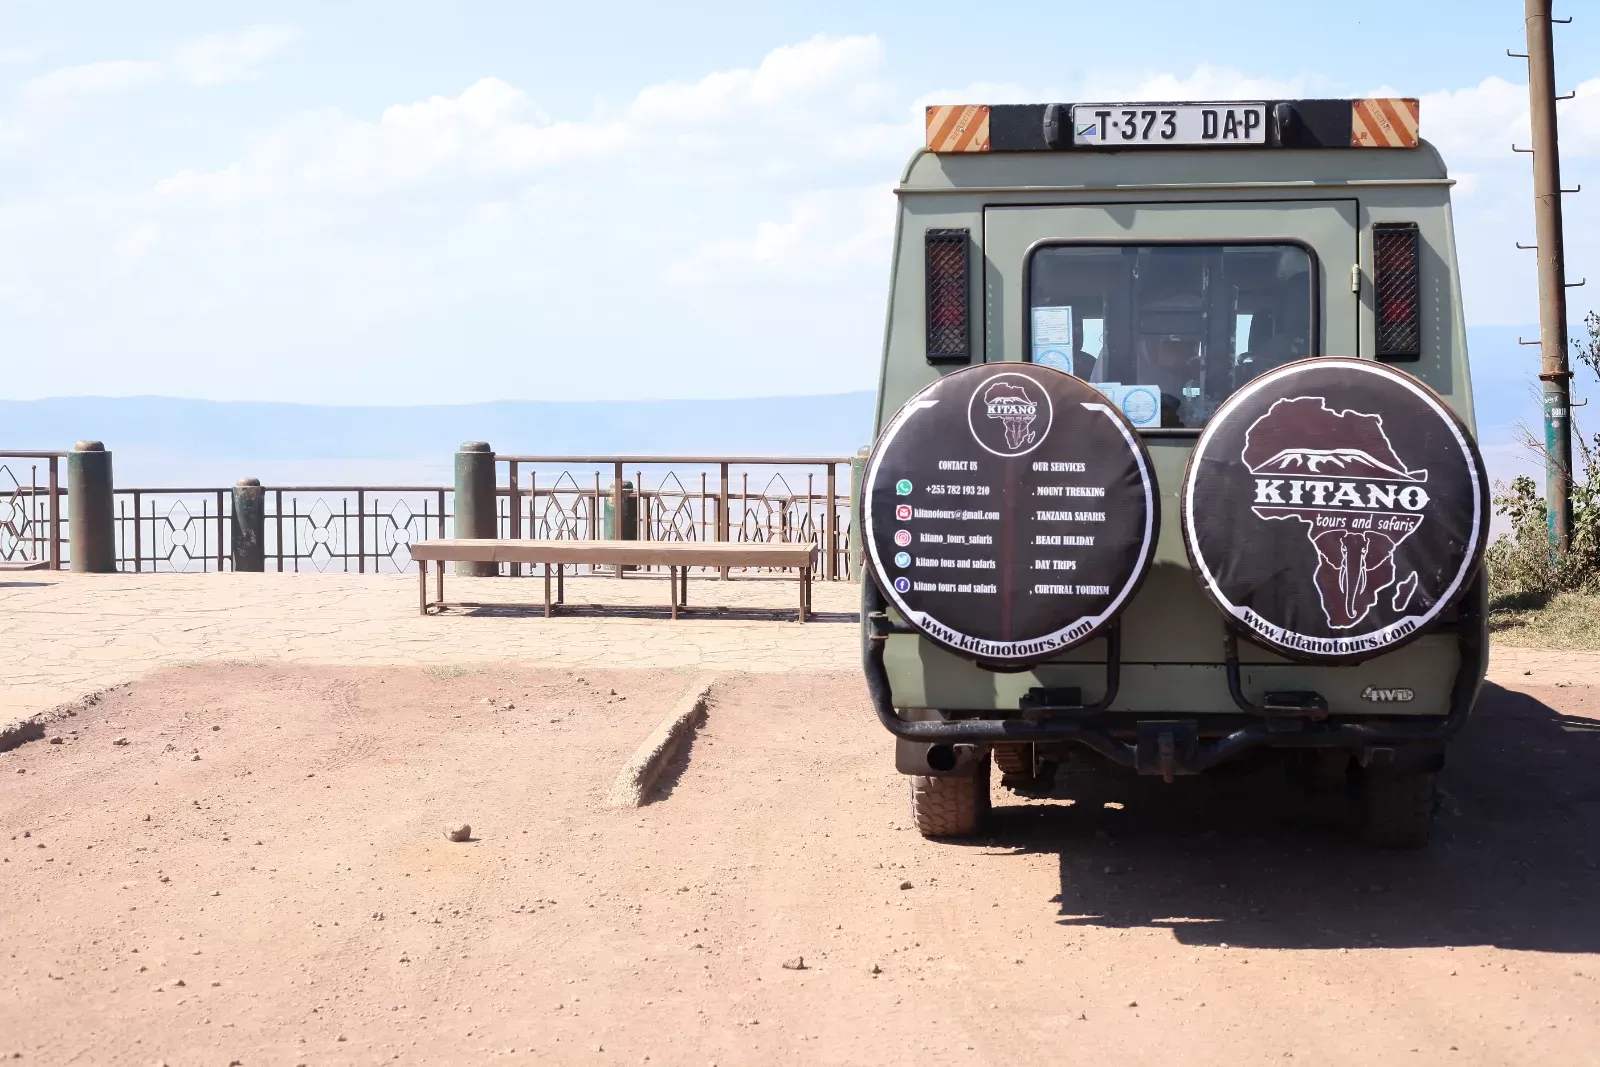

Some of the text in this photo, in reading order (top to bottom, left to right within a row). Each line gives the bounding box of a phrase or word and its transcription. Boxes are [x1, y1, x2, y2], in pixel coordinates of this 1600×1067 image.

[1094, 109, 1260, 140] T 373 DAP
[987, 406, 1036, 414] KITANO
[938, 460, 978, 471] CONTACT US
[1032, 462, 1085, 472] OUR SERVICES
[926, 485, 990, 495] +255 782 193 210
[1037, 486, 1105, 497] MOUNT TREKKING
[1254, 478, 1430, 511] KITANO
[914, 508, 1000, 521] kitanotours@gmail.com
[1036, 511, 1106, 522] TANZANIA SAFARIS
[1316, 514, 1414, 532] tours and safaris
[920, 533, 993, 545] kitano_tours_safaris
[1036, 536, 1061, 545] BEACH
[916, 557, 938, 567] kitano
[957, 558, 970, 568] and
[972, 559, 996, 569] safaris
[1035, 560, 1076, 570] DAY TRIPS
[914, 581, 996, 594] kitano tours and safaris
[1034, 584, 1110, 595] CURTURAL TOURISM
[921, 616, 1094, 656] www.kitanotours.com
[1243, 610, 1416, 654] www.kitanotours.com
[1362, 686, 1414, 702] 4WD
